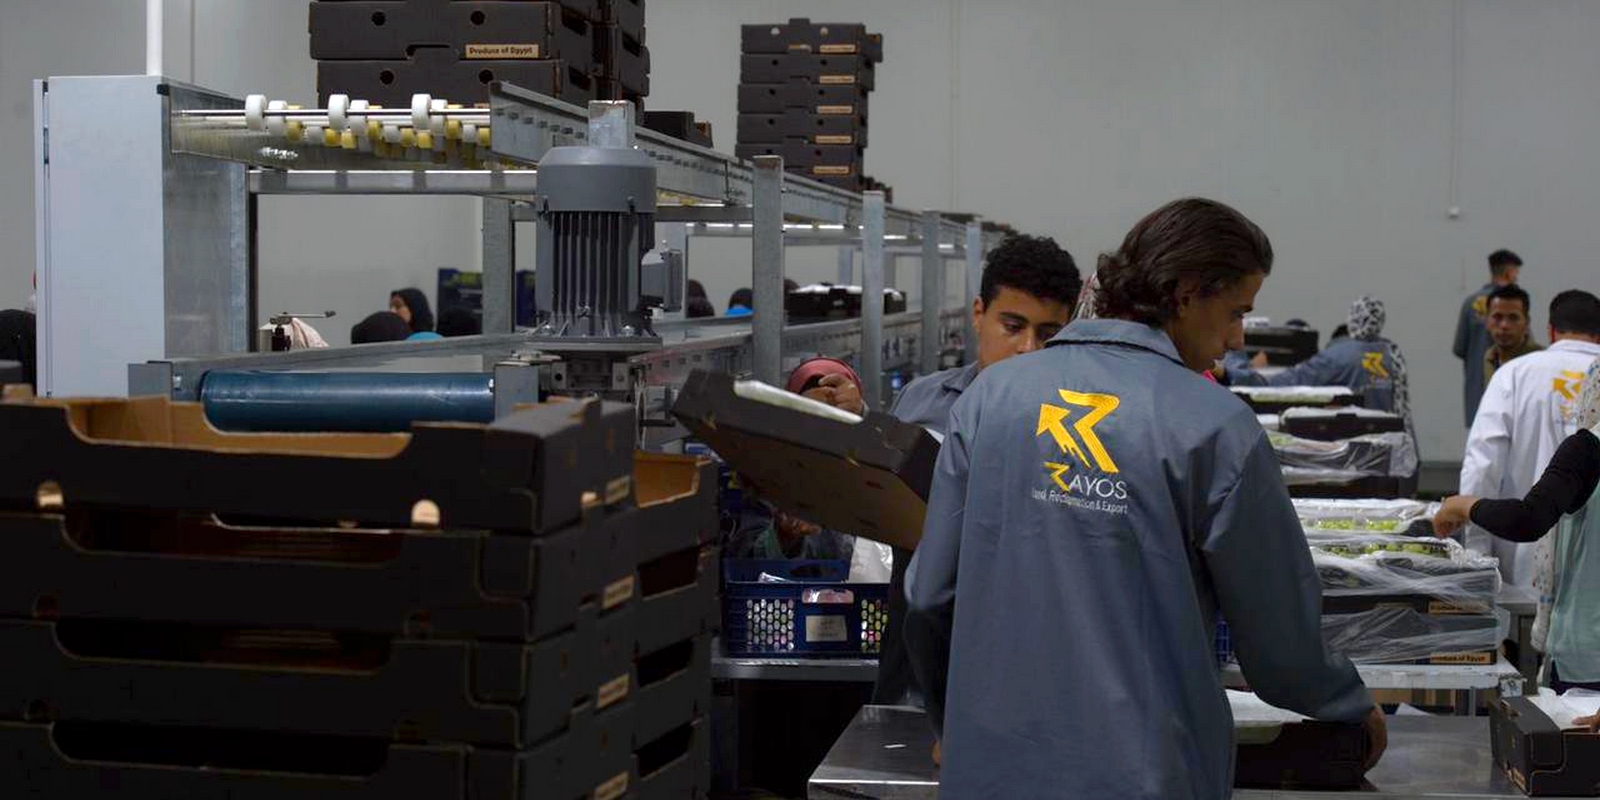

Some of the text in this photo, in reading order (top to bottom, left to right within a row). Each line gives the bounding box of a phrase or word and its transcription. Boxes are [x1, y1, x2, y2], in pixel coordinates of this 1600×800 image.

[469, 46, 533, 55] Produce of Egypt
